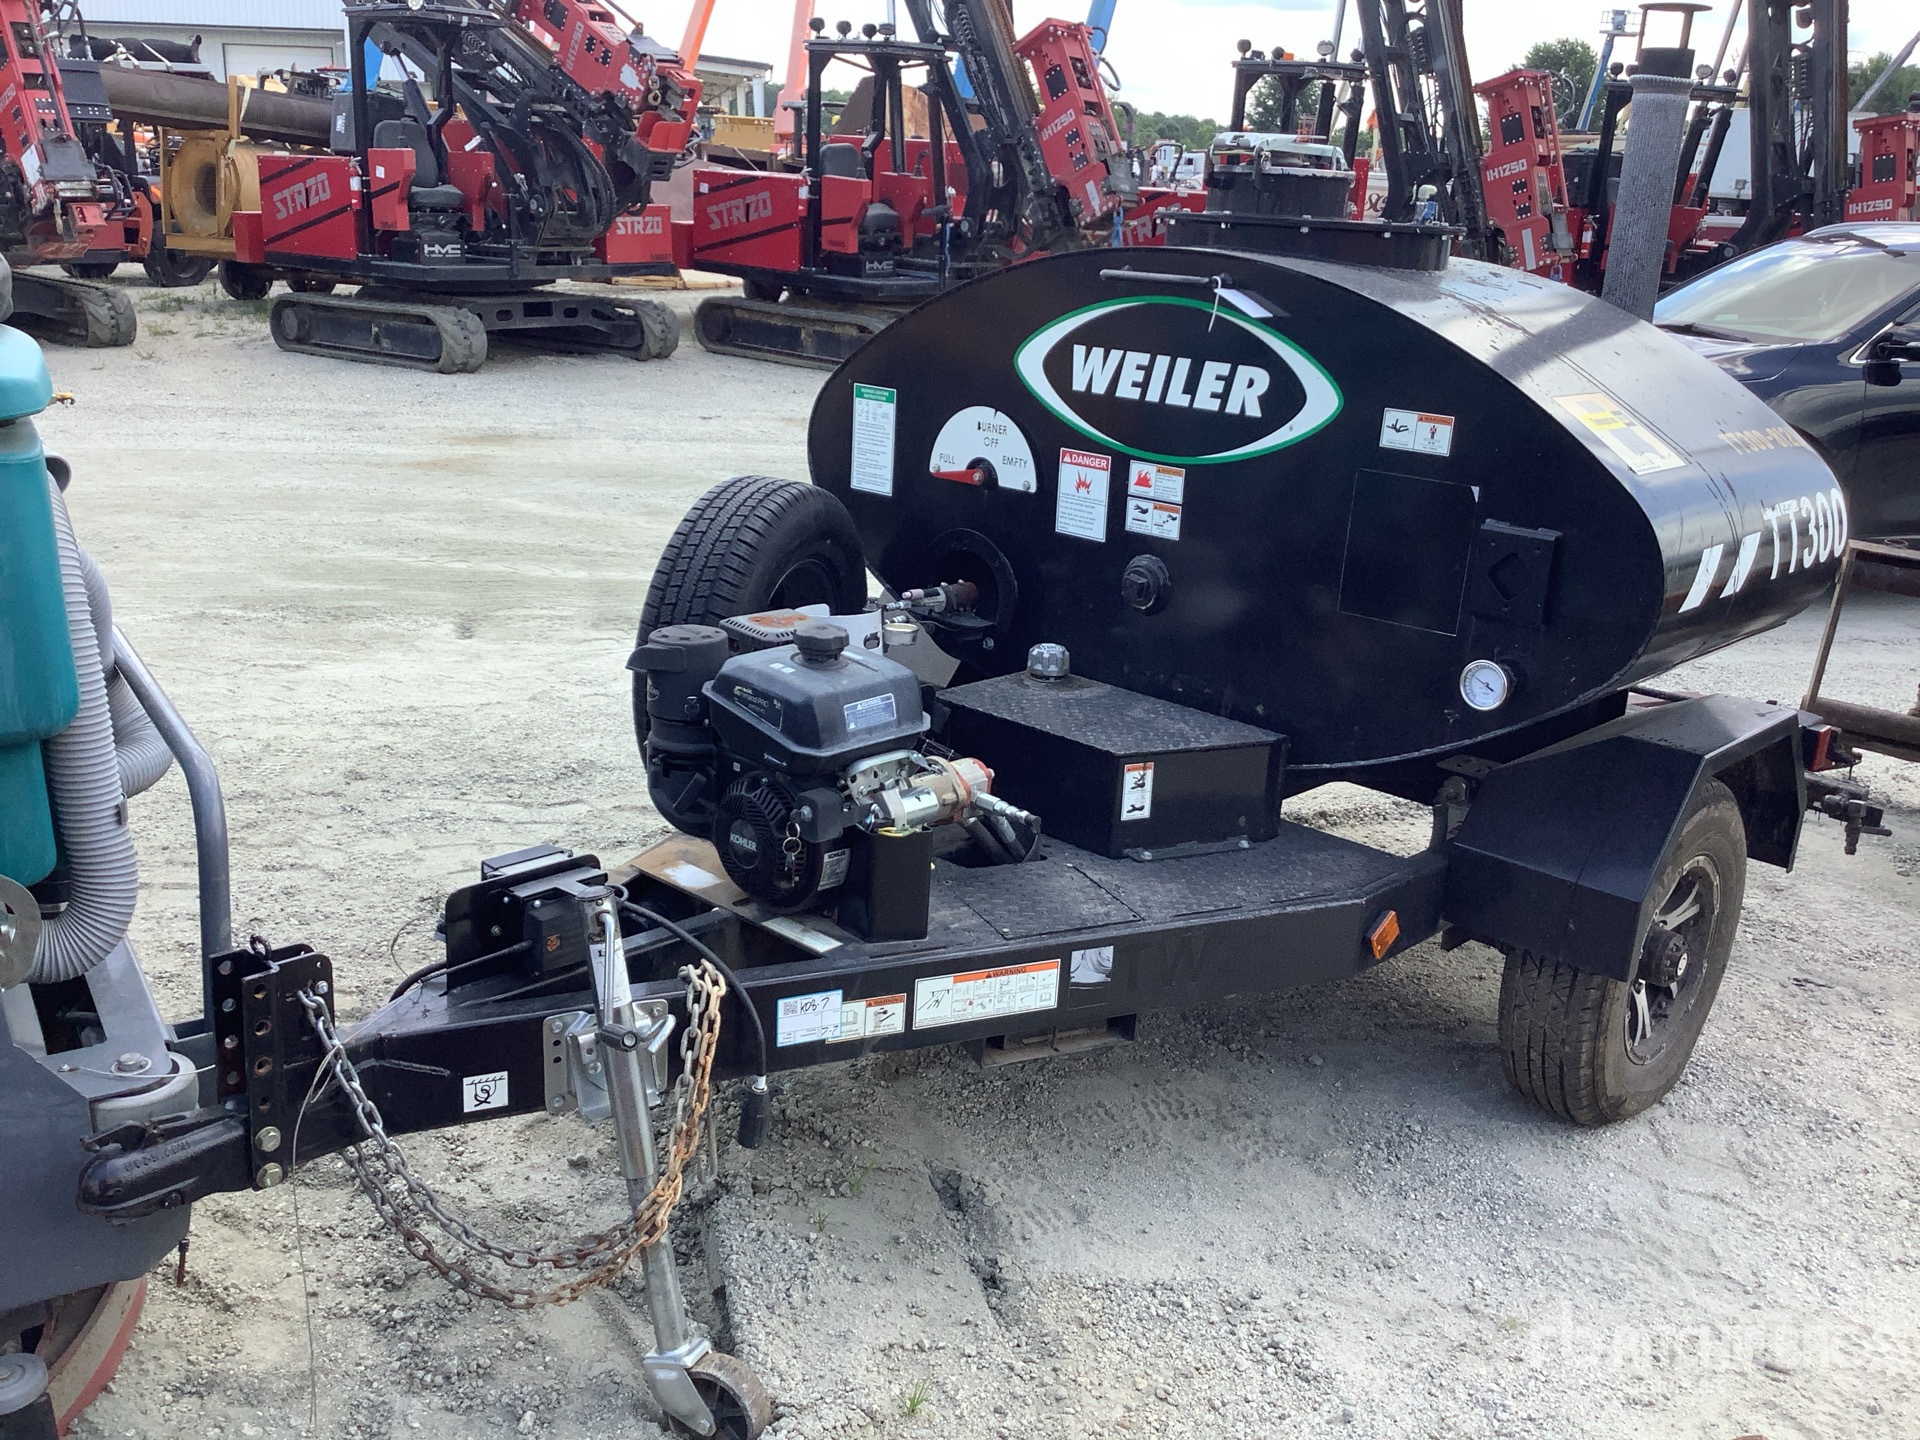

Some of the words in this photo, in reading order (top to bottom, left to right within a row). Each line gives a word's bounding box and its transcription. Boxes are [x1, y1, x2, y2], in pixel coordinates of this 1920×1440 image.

[1041, 108, 1076, 141] IH1250
[1486, 158, 1527, 182] IH1250
[273, 172, 332, 220] STR20
[706, 190, 773, 231] STR20
[1849, 199, 1893, 215] IH1250
[615, 216, 663, 235] STR20
[423, 244, 461, 254] HMC
[866, 260, 893, 271] HMC
[1072, 343, 1270, 418] WEILER
[977, 421, 1008, 436] BURNER
[983, 436, 999, 448] OFF
[939, 453, 955, 465] FULL
[1002, 455, 1028, 469] EMPTY
[1072, 454, 1107, 469] DANGER
[1761, 487, 1848, 580] TT300
[729, 832, 757, 852] KOHLER
[991, 966, 1027, 978] WARNING
